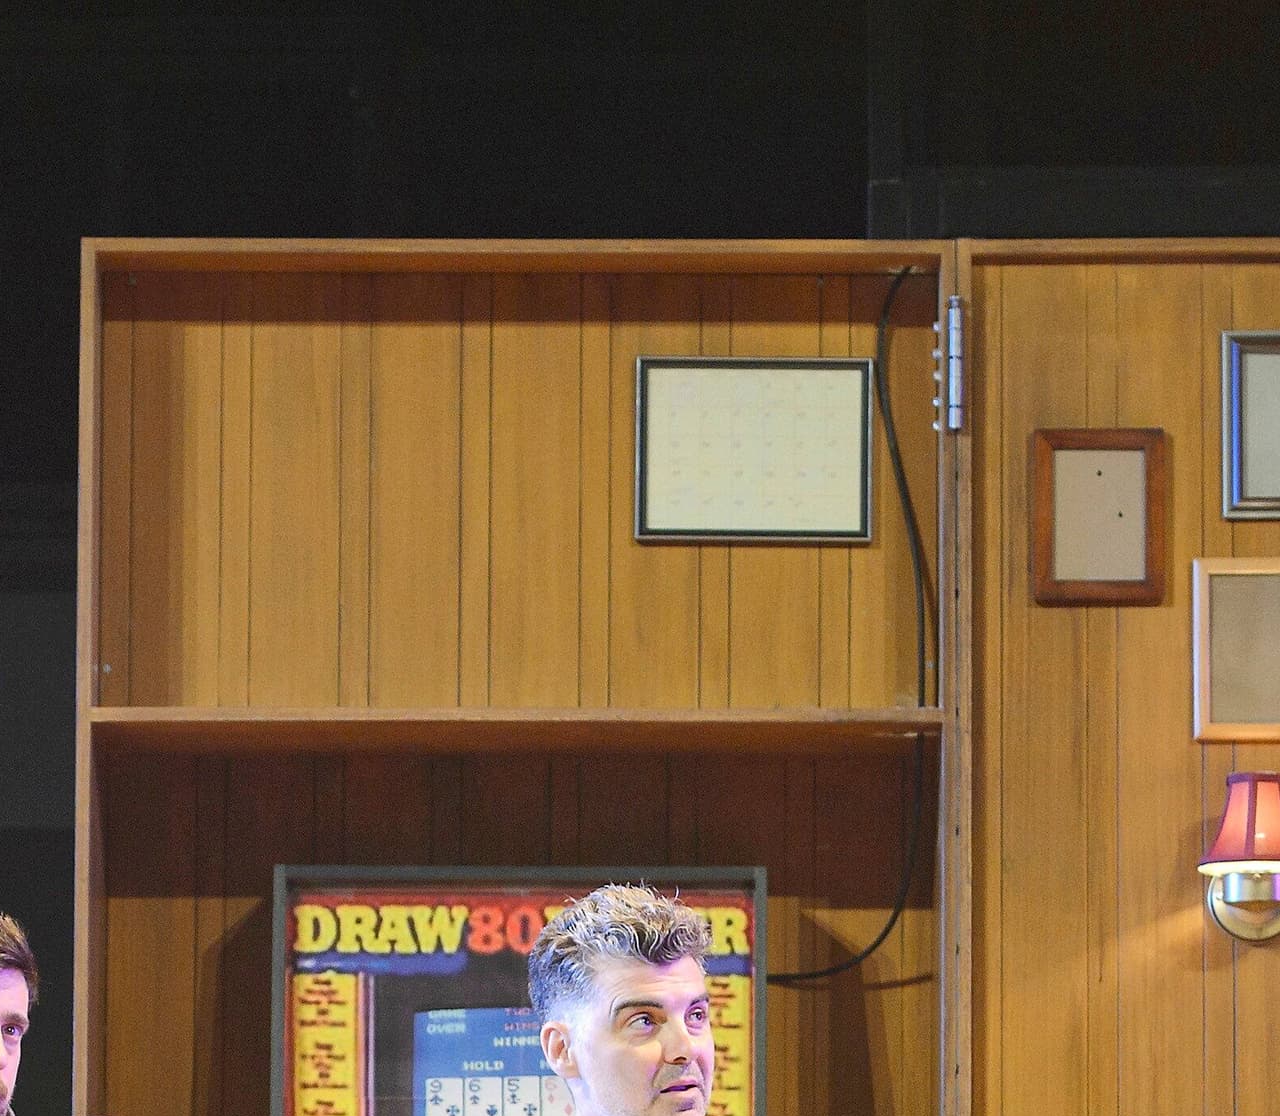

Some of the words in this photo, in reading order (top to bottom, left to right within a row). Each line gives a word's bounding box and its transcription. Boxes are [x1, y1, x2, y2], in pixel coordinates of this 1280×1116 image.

[293, 904, 469, 955] DRAW
[467, 906, 544, 955] 80
[463, 1060, 505, 1071] HOLD
[430, 1079, 442, 1093] 9
[468, 1079, 481, 1092] 6
[507, 1078, 520, 1092] 5
